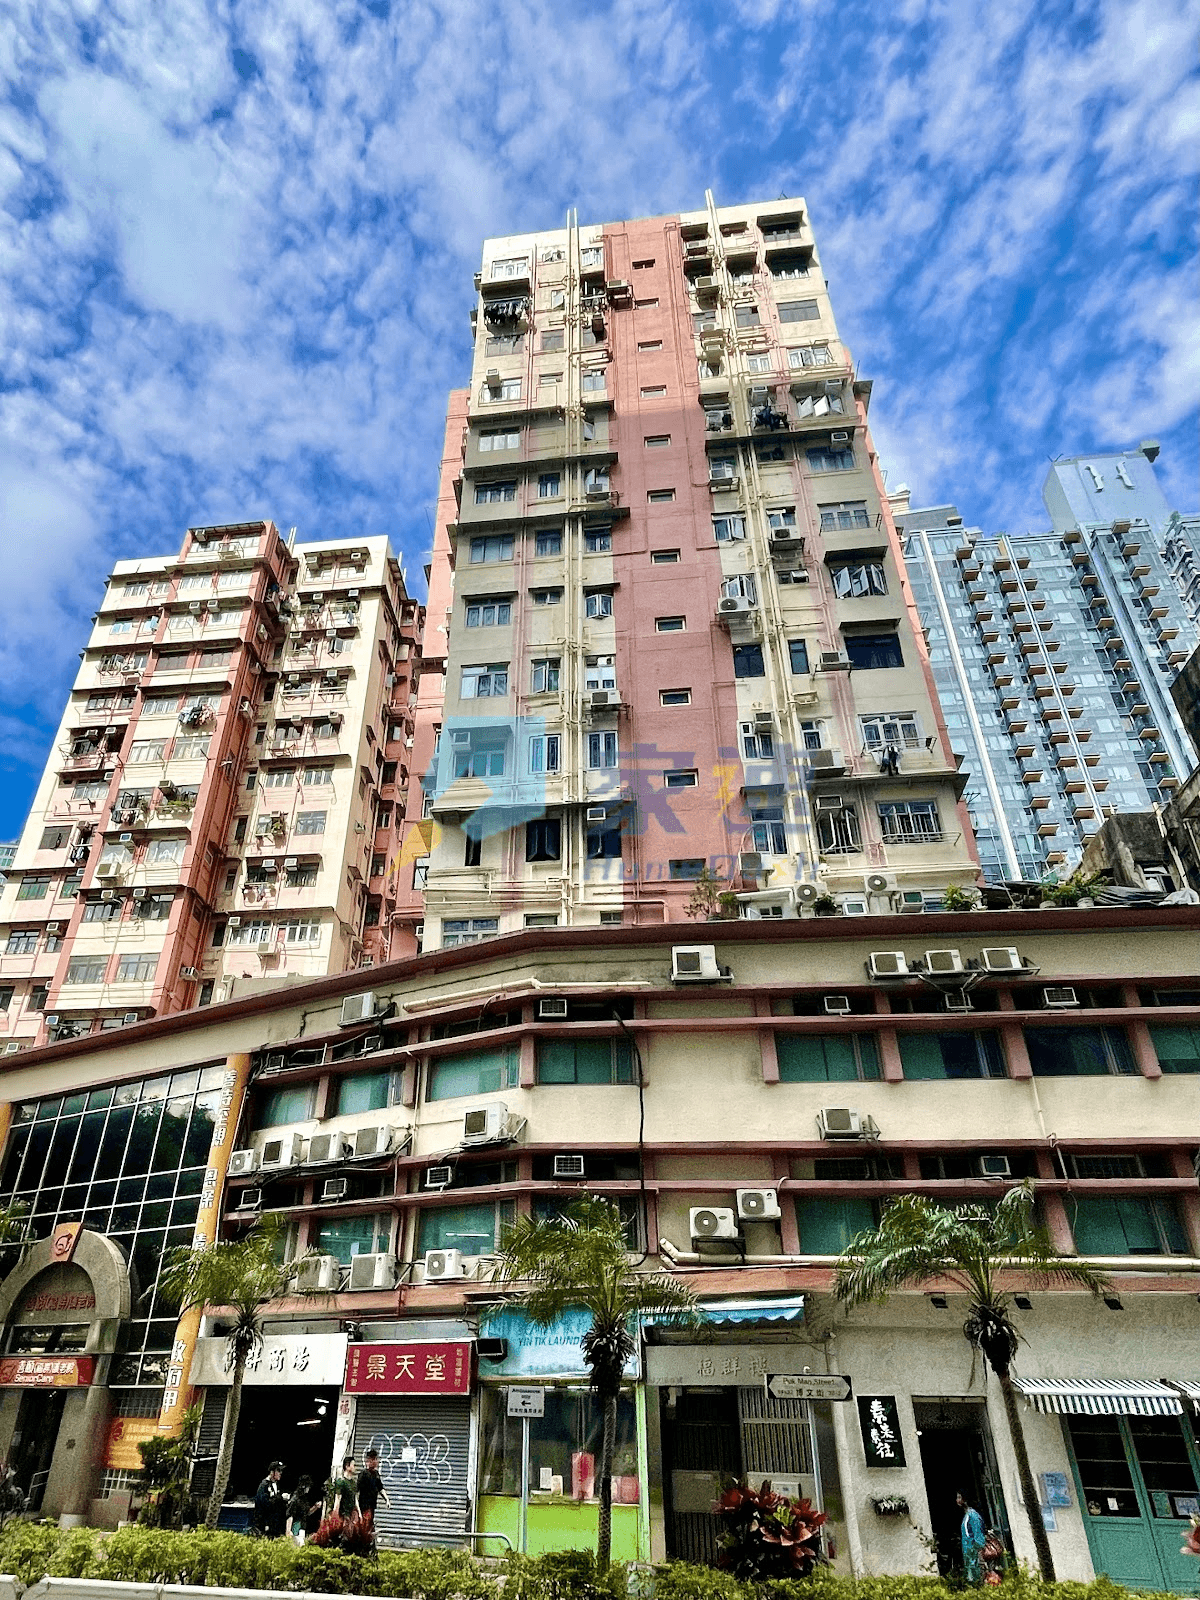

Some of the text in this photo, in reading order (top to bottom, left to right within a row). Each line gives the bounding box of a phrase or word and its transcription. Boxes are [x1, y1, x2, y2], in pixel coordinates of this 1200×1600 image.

[365, 1353, 447, 1381] 景天堂
[697, 1356, 771, 1378] 福群樓
[797, 1378, 813, 1386] Man
[813, 1378, 835, 1386] Street
